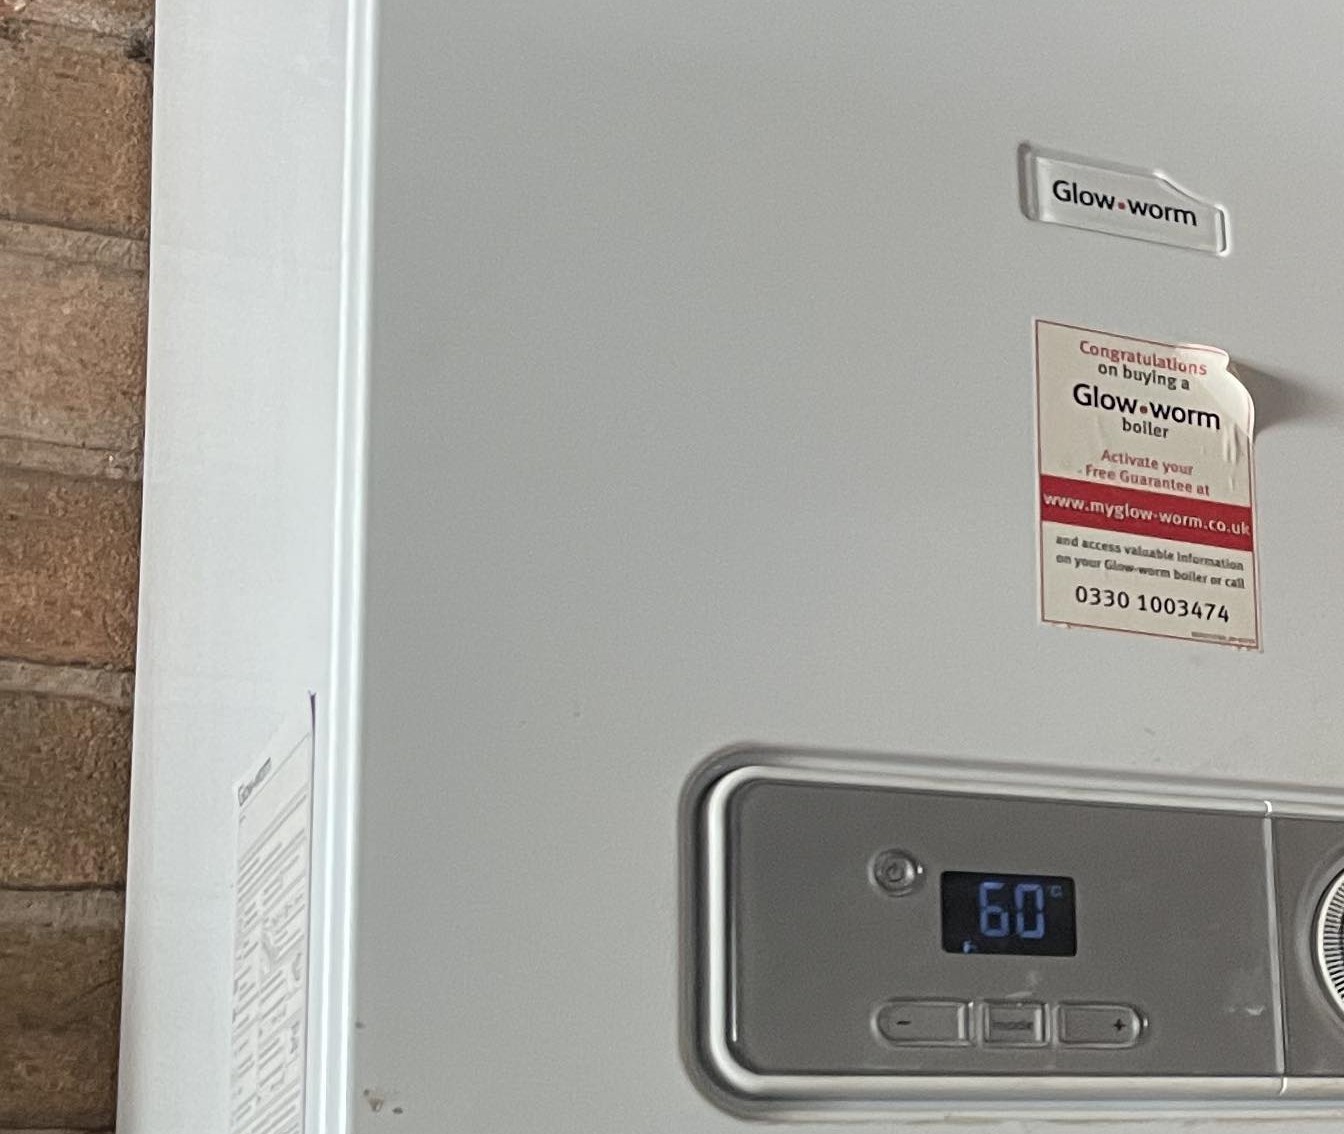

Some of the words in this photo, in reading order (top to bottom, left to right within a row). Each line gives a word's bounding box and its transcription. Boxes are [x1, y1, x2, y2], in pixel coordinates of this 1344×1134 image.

[1079, 340, 1207, 375] Congratulations
[1098, 363, 1118, 376] on
[1123, 365, 1177, 390] buying
[1181, 378, 1190, 390] a
[1122, 417, 1169, 439] boiler
[1101, 449, 1159, 470] Activate
[1162, 461, 1194, 476] your
[1085, 464, 1116, 480] Free
[1119, 470, 1193, 493] Guarantee
[1196, 484, 1210, 497] at
[1043, 494, 1250, 536] www.myglow-worm.co.uk
[1056, 535, 1079, 548] and
[1081, 540, 1121, 553] access
[1124, 545, 1174, 561] valuable
[1177, 551, 1244, 571] information
[1056, 554, 1072, 564] on
[1074, 557, 1101, 569] your
[1104, 559, 1171, 578] Glow-worm
[1174, 569, 1208, 584] boiler
[1210, 576, 1222, 586] or
[1224, 578, 1245, 589] call
[1075, 585, 1130, 609] 0330
[1137, 594, 1230, 623] 1003474
[978, 881, 1046, 939] 60
